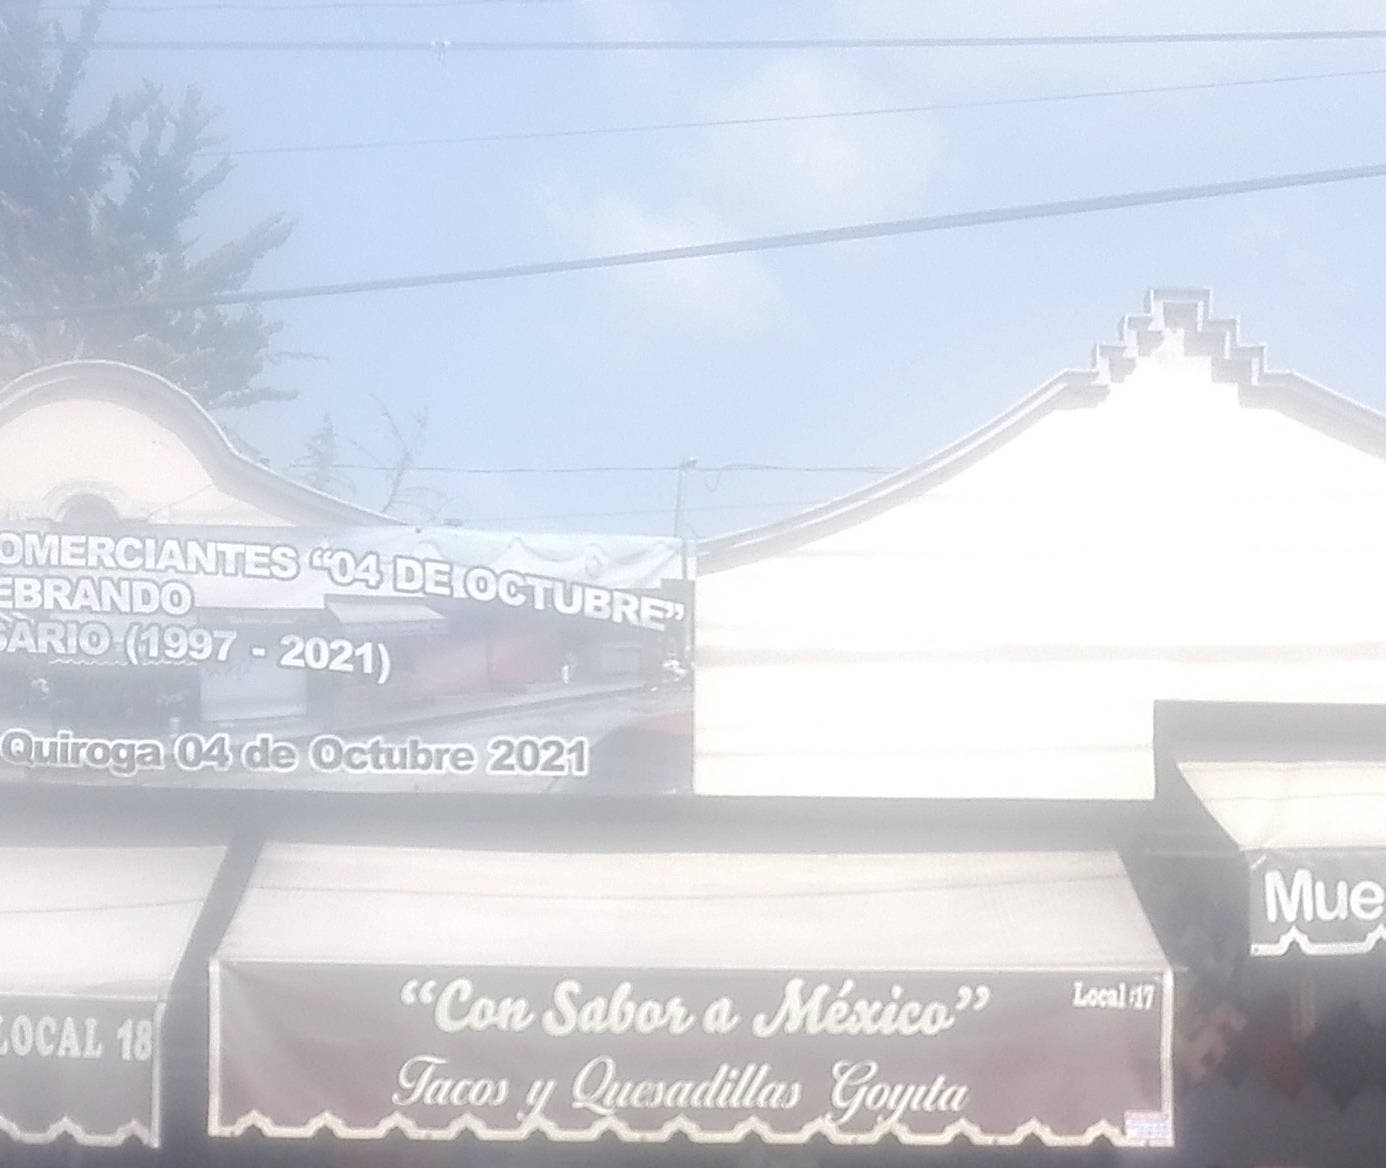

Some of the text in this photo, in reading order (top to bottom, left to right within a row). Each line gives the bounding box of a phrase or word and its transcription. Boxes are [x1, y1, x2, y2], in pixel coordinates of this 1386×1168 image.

[395, 556, 452, 596] DE
[124, 623, 238, 665] (1997
[278, 633, 391, 685] 2021)
[173, 733, 234, 770] 04
[239, 732, 300, 772] de
[309, 734, 480, 774] Octubre
[486, 735, 593, 776] 2021
[541, 980, 697, 1037] Sabor
[701, 996, 742, 1035] a
[1072, 980, 1127, 1009] Local
[116, 1016, 155, 1064] 18
[391, 1053, 511, 1107] Tacos
[514, 1076, 559, 1126] y
[569, 1054, 803, 1117] Quesadillas
